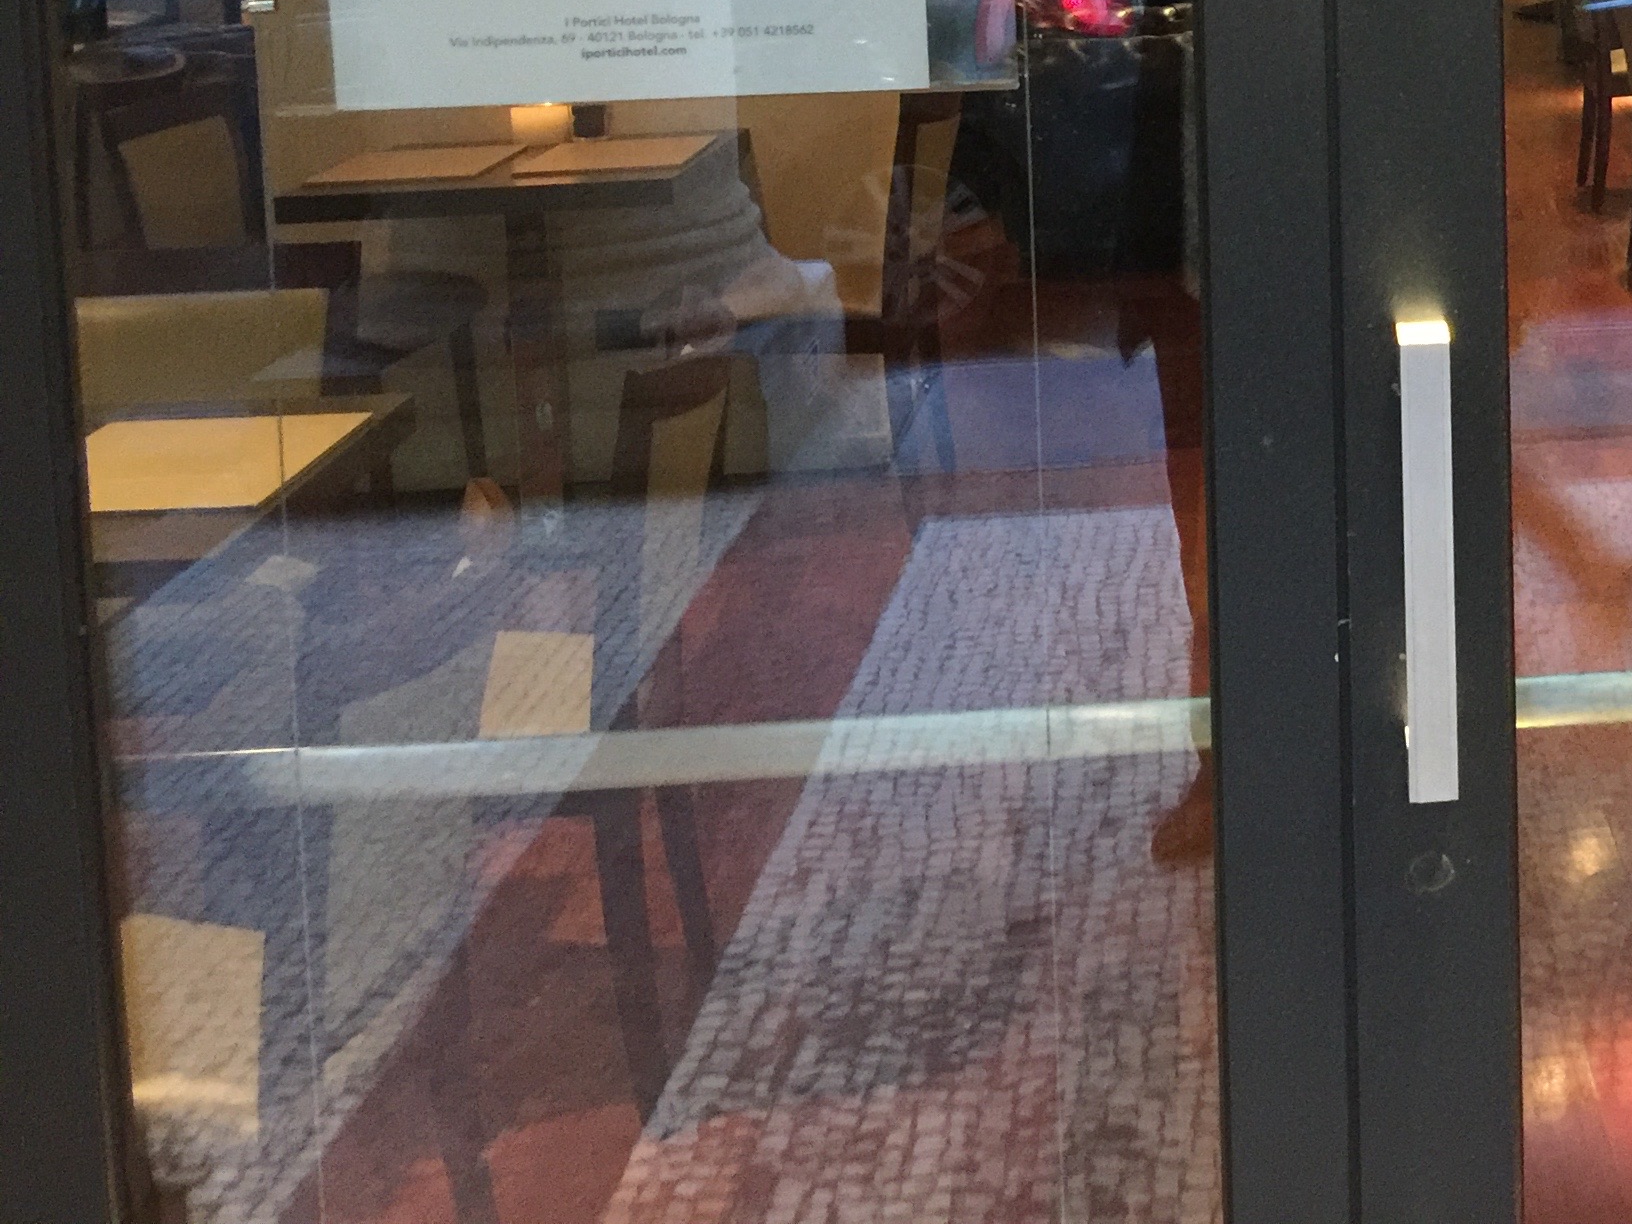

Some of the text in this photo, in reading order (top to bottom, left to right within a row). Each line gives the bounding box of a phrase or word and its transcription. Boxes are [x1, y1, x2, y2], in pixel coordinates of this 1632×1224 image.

[573, 16, 611, 27] Portici
[614, 15, 648, 26] Hotel
[651, 14, 700, 26] Bologna
[449, 36, 469, 47] Via
[628, 30, 678, 43] Bologna
[738, 26, 759, 37] 051
[580, 44, 687, 60] iporticihotel.com
